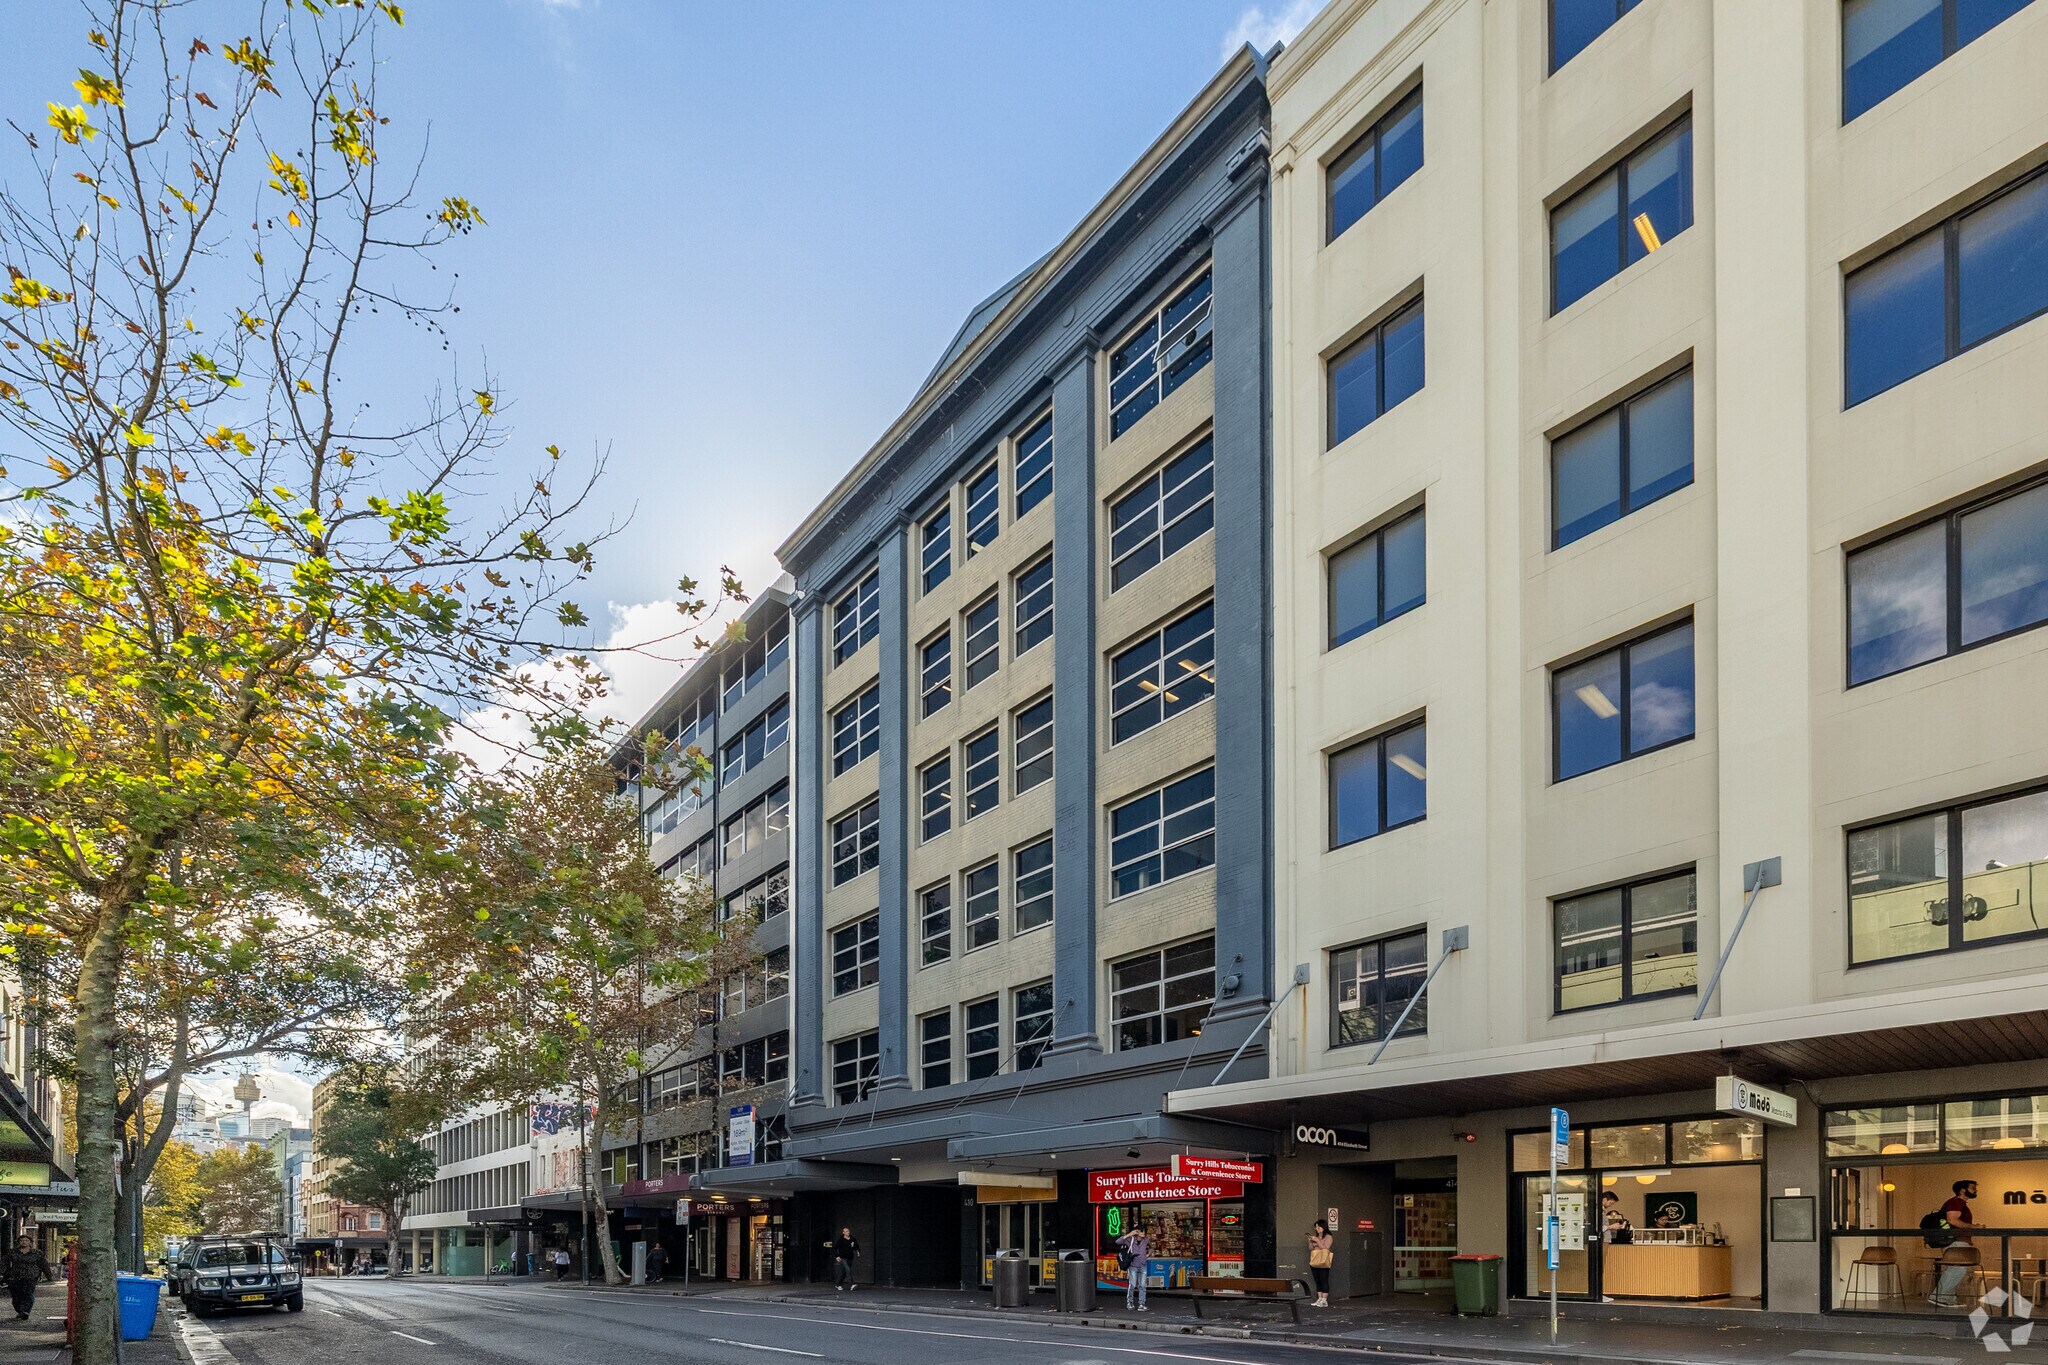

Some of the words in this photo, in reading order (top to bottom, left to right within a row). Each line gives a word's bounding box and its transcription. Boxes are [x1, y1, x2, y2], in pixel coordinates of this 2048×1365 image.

[1297, 1125, 1337, 1145] acon
[1186, 1158, 1204, 1168] Surry
[1205, 1160, 1220, 1169] Hills
[1220, 1161, 1255, 1172] Tobacconist
[1096, 1176, 1126, 1188] Surry
[1128, 1172, 1154, 1184] Hills
[1197, 1168, 1234, 1179] Convenience
[1235, 1172, 1252, 1180] Store
[645, 1179, 663, 1188] PORTERS
[1104, 1189, 1112, 1200] &
[1114, 1187, 1186, 1200] Convenience
[1187, 1185, 1221, 1197] Store
[697, 1203, 735, 1211] PORTERS
[750, 1202, 769, 1210] PORTERS
